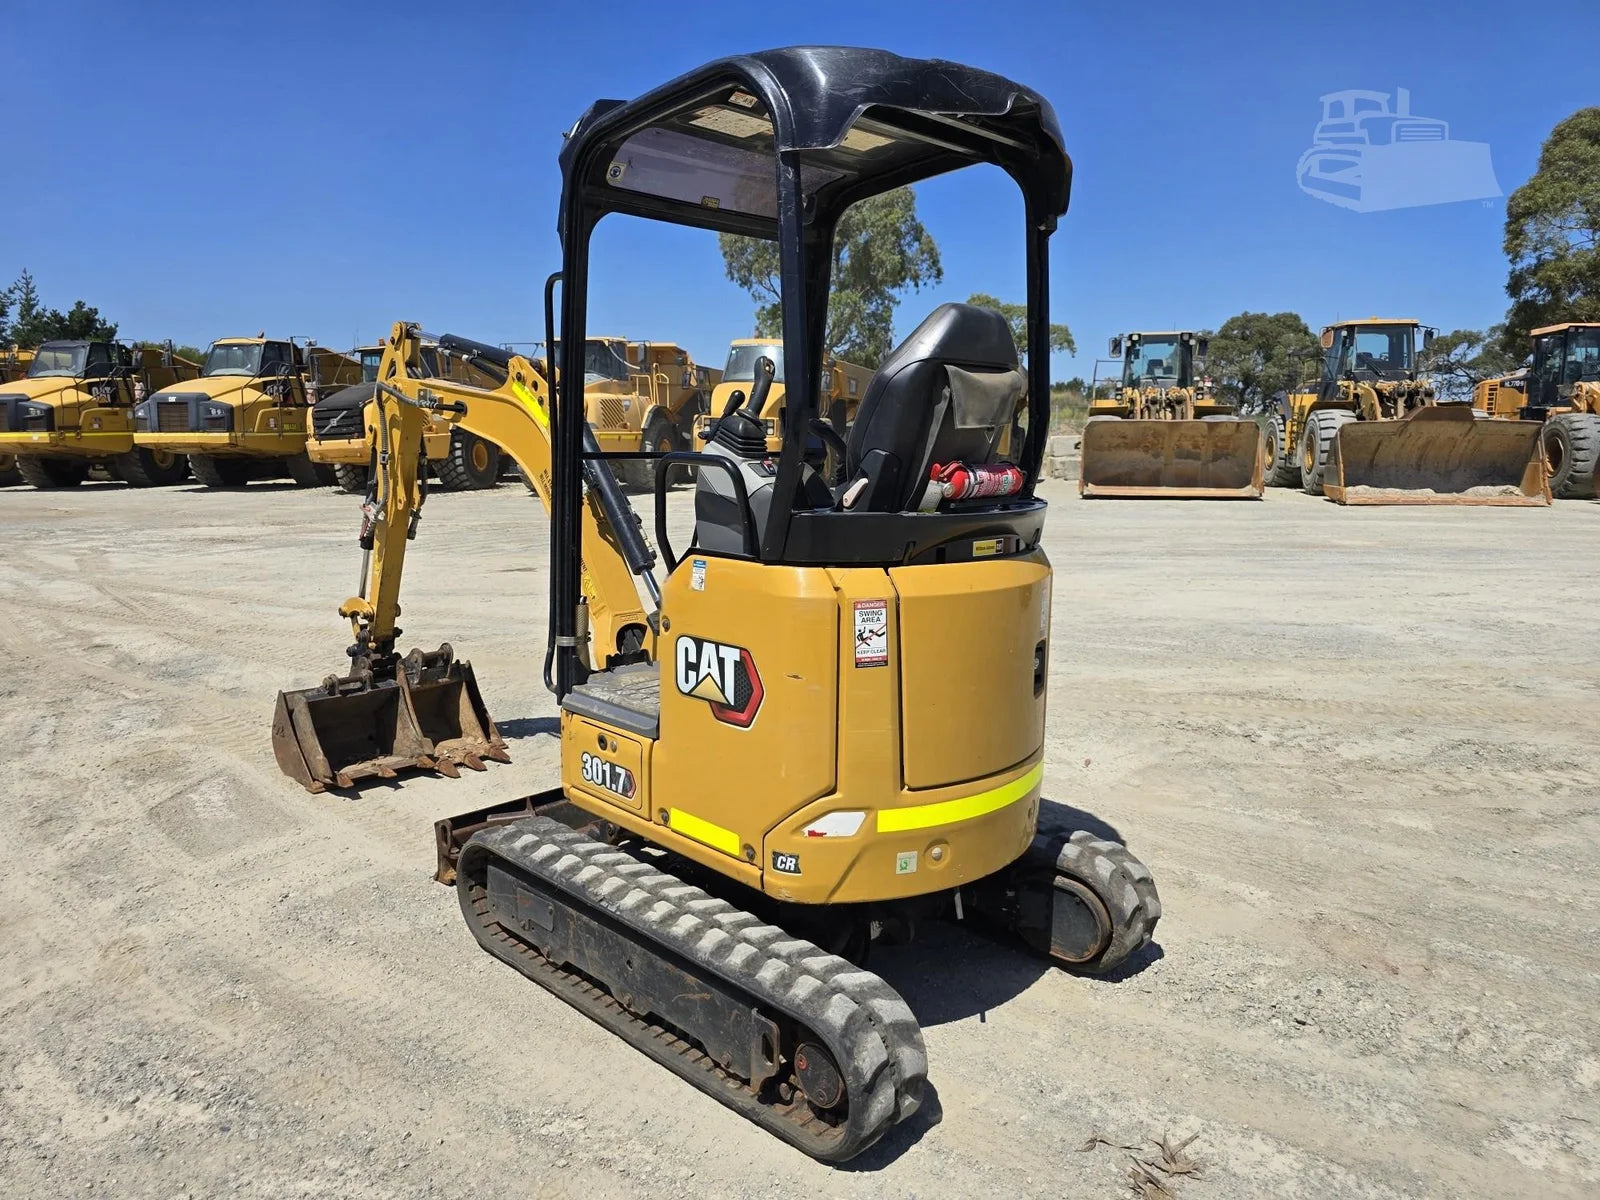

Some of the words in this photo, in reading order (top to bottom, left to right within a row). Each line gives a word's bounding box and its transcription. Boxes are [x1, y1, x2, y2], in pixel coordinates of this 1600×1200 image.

[676, 636, 741, 706] CAT
[582, 752, 626, 794] 301.7
[776, 855, 796, 871] CR
